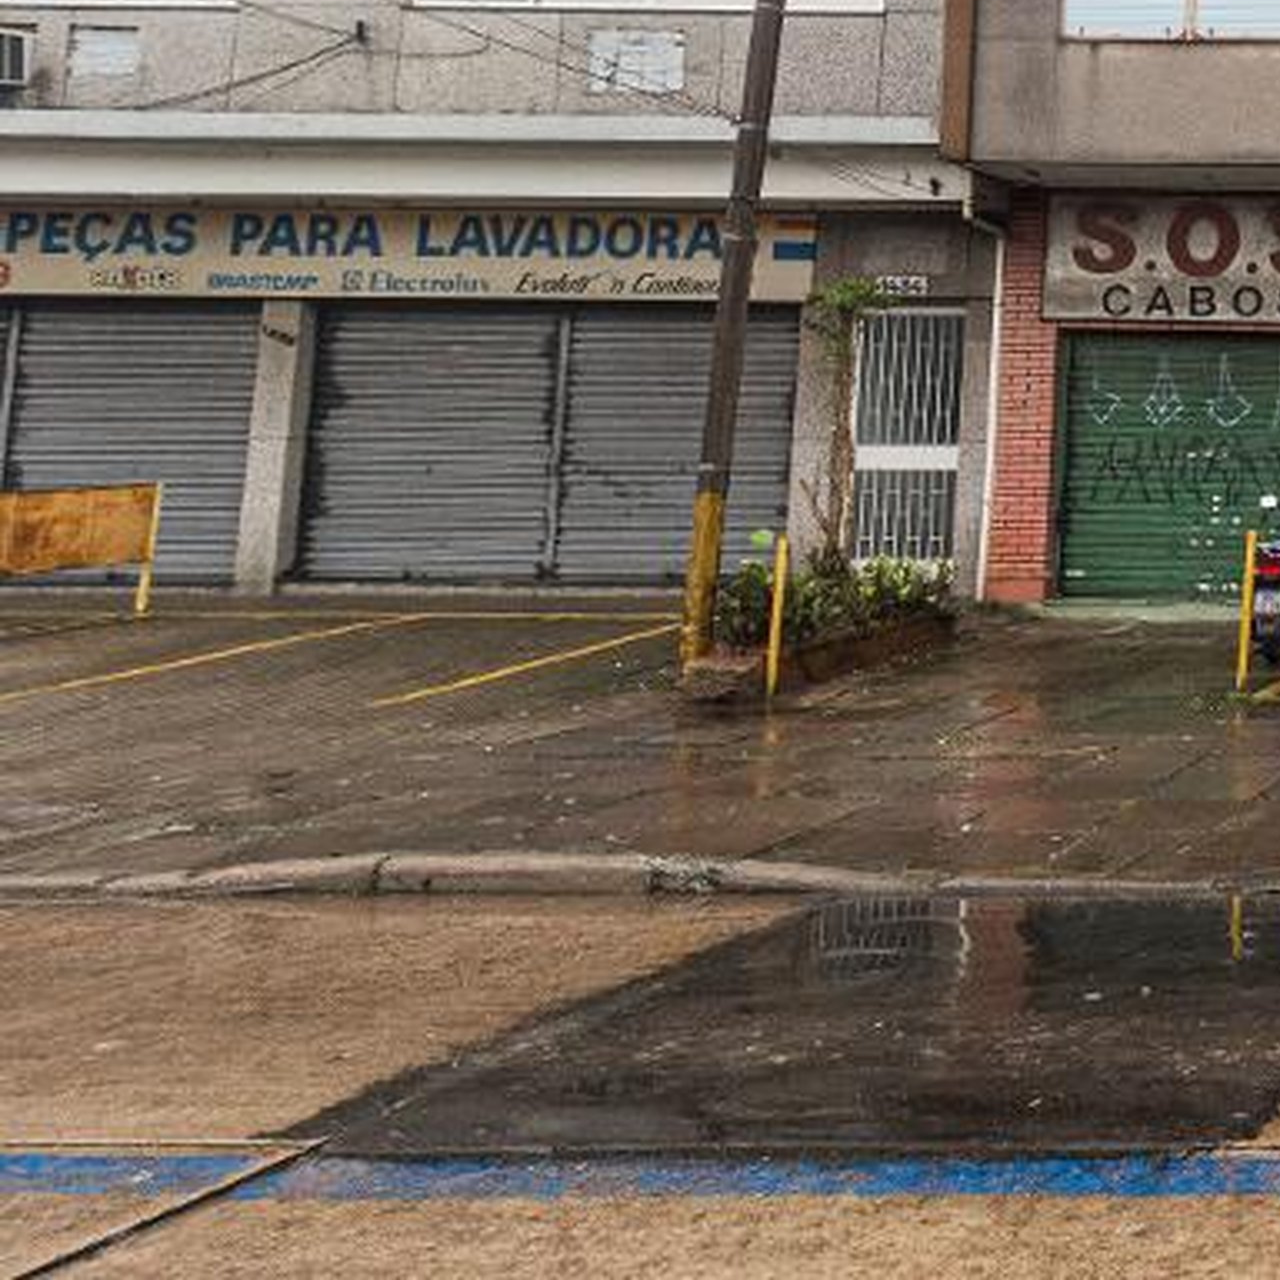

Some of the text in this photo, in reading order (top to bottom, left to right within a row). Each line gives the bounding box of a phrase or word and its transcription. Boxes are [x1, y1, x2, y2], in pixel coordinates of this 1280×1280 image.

[4, 212, 722, 262] PEÇAS PARA LAVADORA
